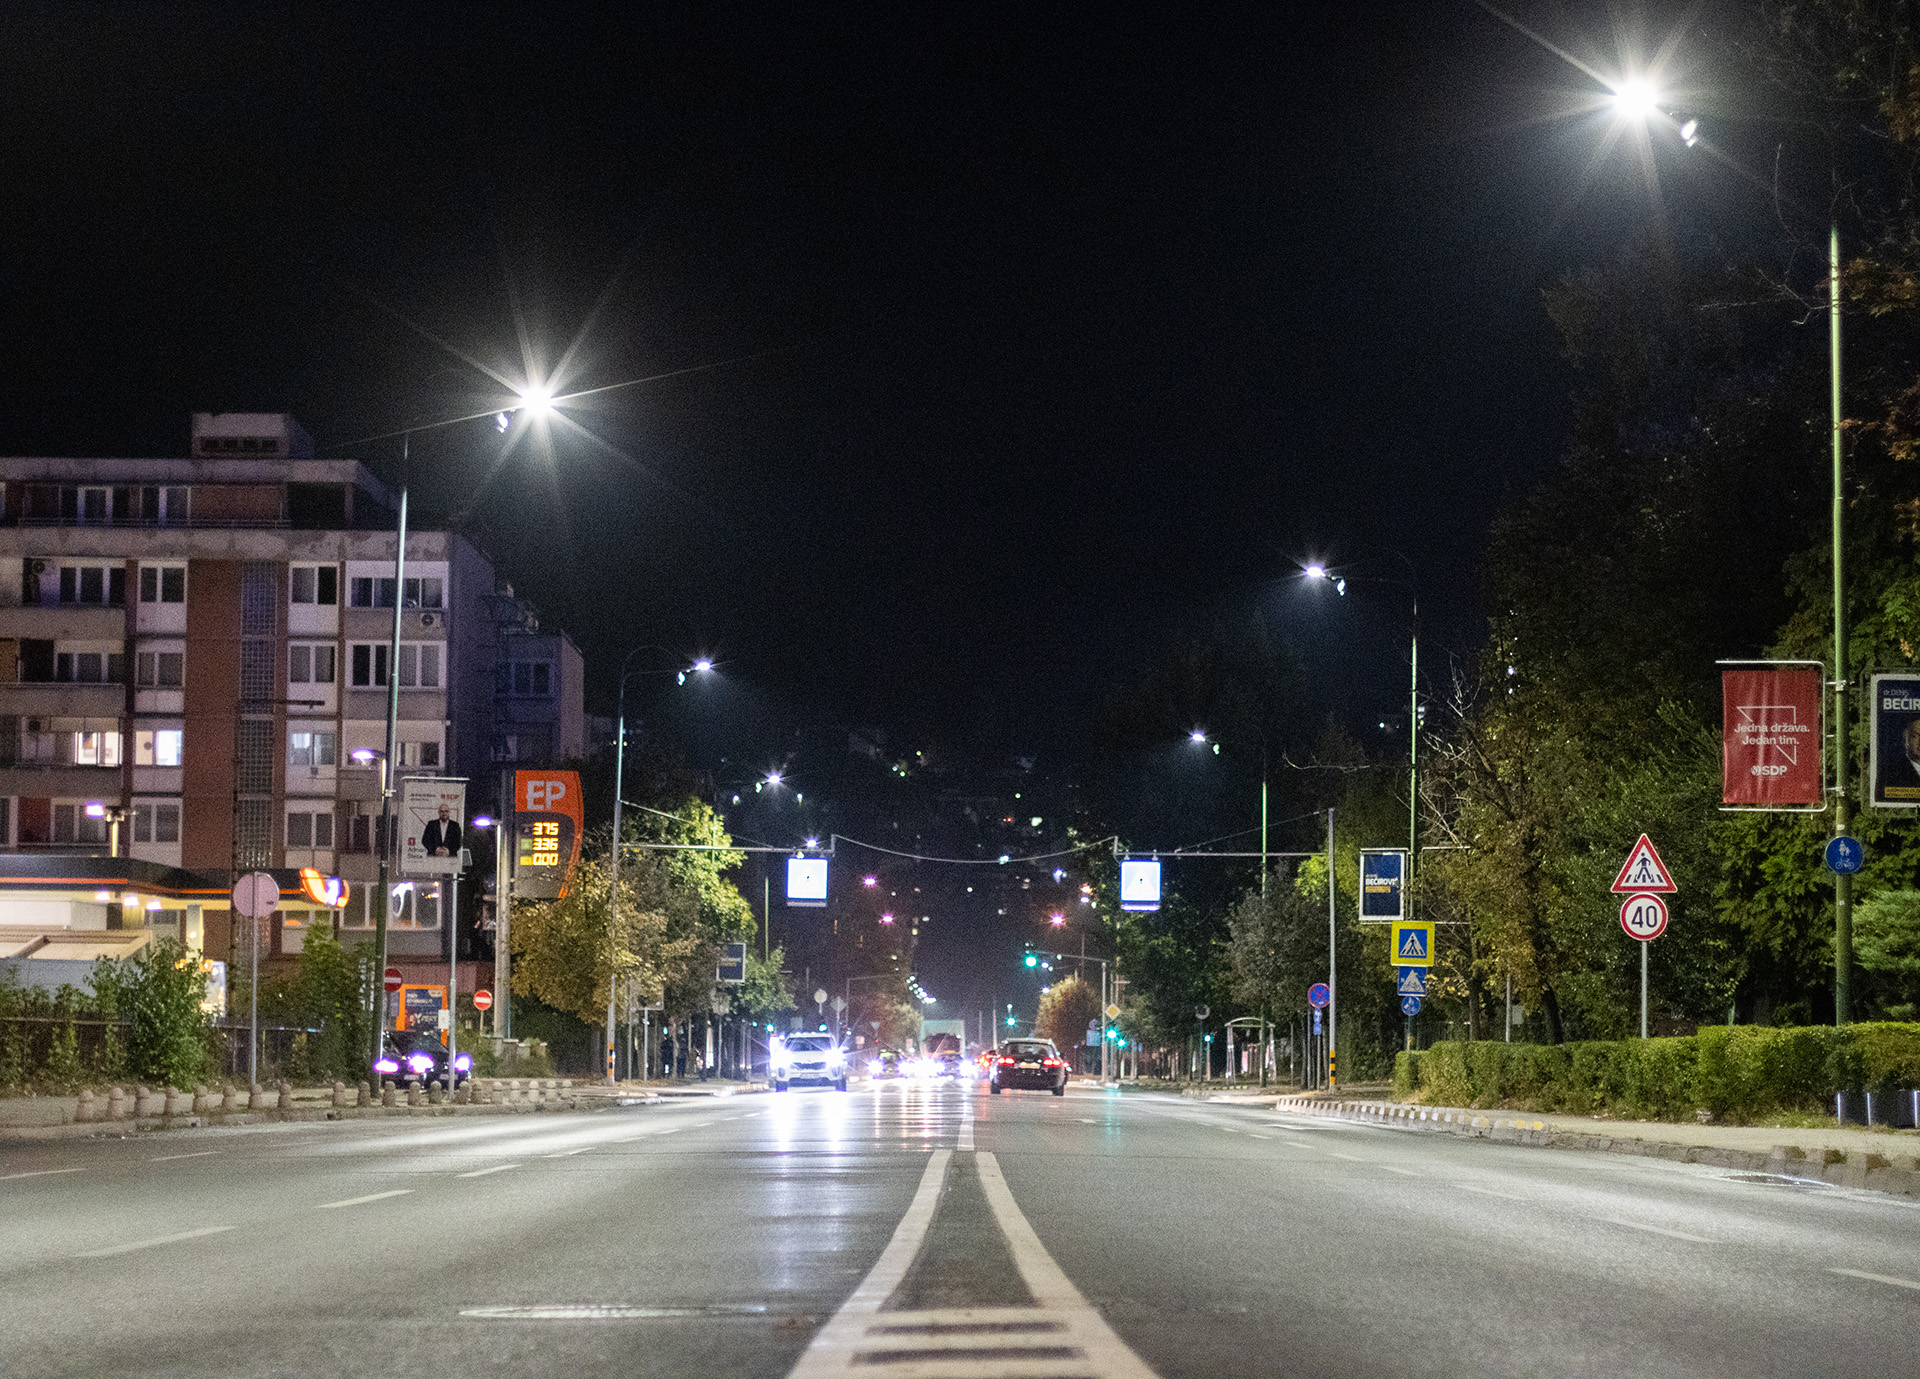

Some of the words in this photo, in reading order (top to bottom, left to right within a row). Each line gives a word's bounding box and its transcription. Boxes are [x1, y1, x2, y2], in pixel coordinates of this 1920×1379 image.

[1734, 723, 1768, 733] Jedna
[1770, 722, 1810, 733] država.
[1742, 735, 1776, 745] Jedan
[1779, 735, 1800, 745] tim.
[1762, 765, 1788, 776] SDP
[526, 780, 566, 810] EP
[1631, 905, 1658, 928] 40
